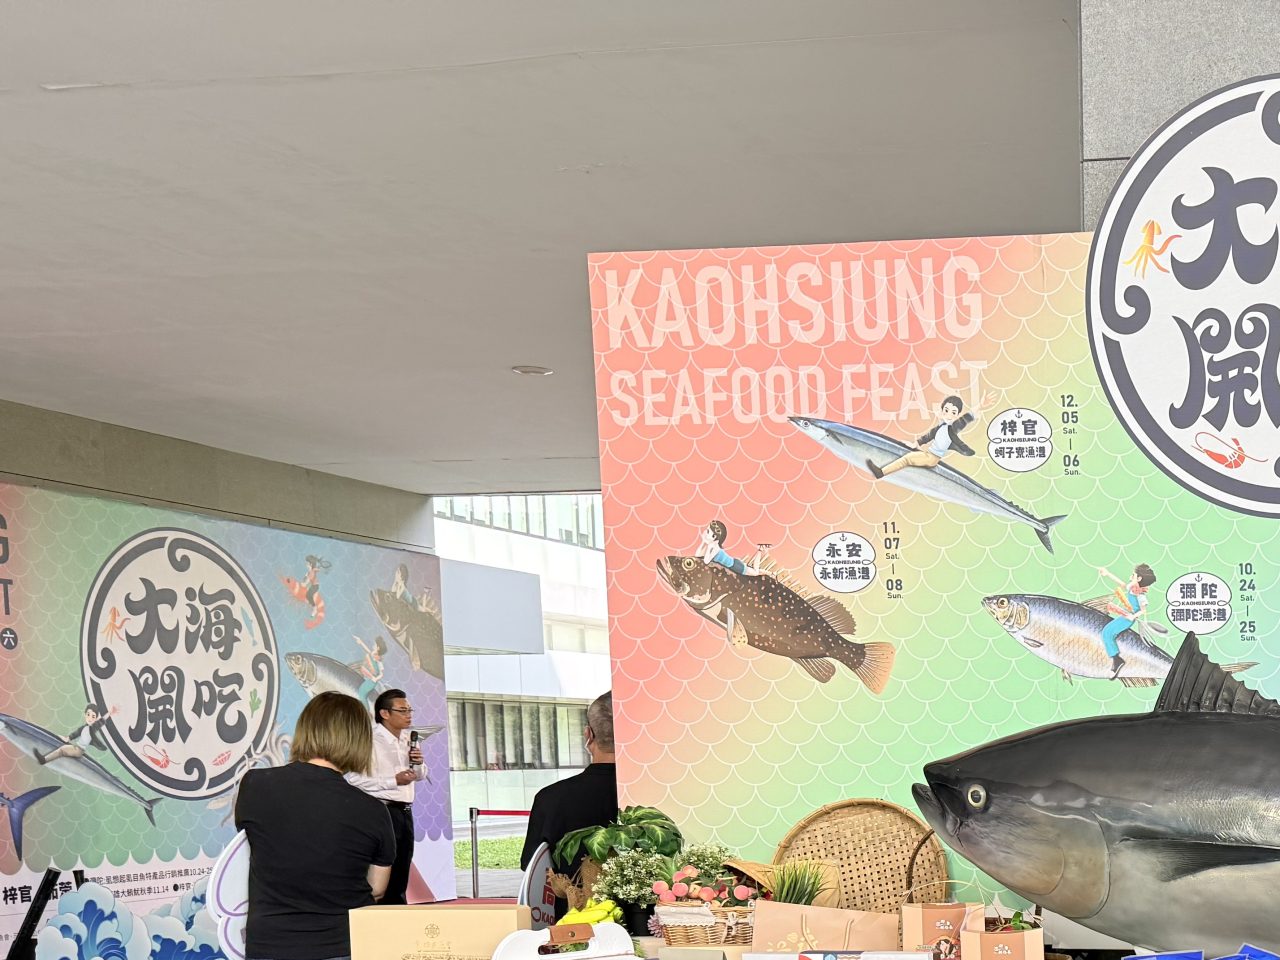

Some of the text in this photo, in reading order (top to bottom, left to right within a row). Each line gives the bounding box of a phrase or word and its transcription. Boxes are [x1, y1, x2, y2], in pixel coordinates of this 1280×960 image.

[604, 255, 983, 349] KAOHSIUNG
[609, 360, 988, 427] SEAFOOD FEAST
[1060, 394, 1078, 408] 12.
[1061, 411, 1079, 424] 05
[1000, 419, 1038, 436] 梓官
[1062, 427, 1078, 435] Sat.
[1063, 454, 1080, 467] 06
[1064, 468, 1081, 476] Sun.
[883, 521, 900, 534] 11.
[826, 542, 862, 558] 永安
[884, 537, 900, 550] 07
[885, 552, 900, 560] Sat.
[819, 566, 870, 580] 永新漁港
[1238, 562, 1256, 575] 10.
[886, 578, 903, 591] 08
[1179, 582, 1218, 599] 彌陀
[1239, 579, 1256, 592] 24
[1240, 594, 1255, 602] Sat.
[124, 577, 243, 661] 大海
[1171, 608, 1227, 622] 彌陀漁港
[1239, 621, 1256, 633] 25
[1240, 634, 1257, 642] Sun.
[127, 665, 248, 745] 開吃
[2, 885, 32, 905] 梓官
